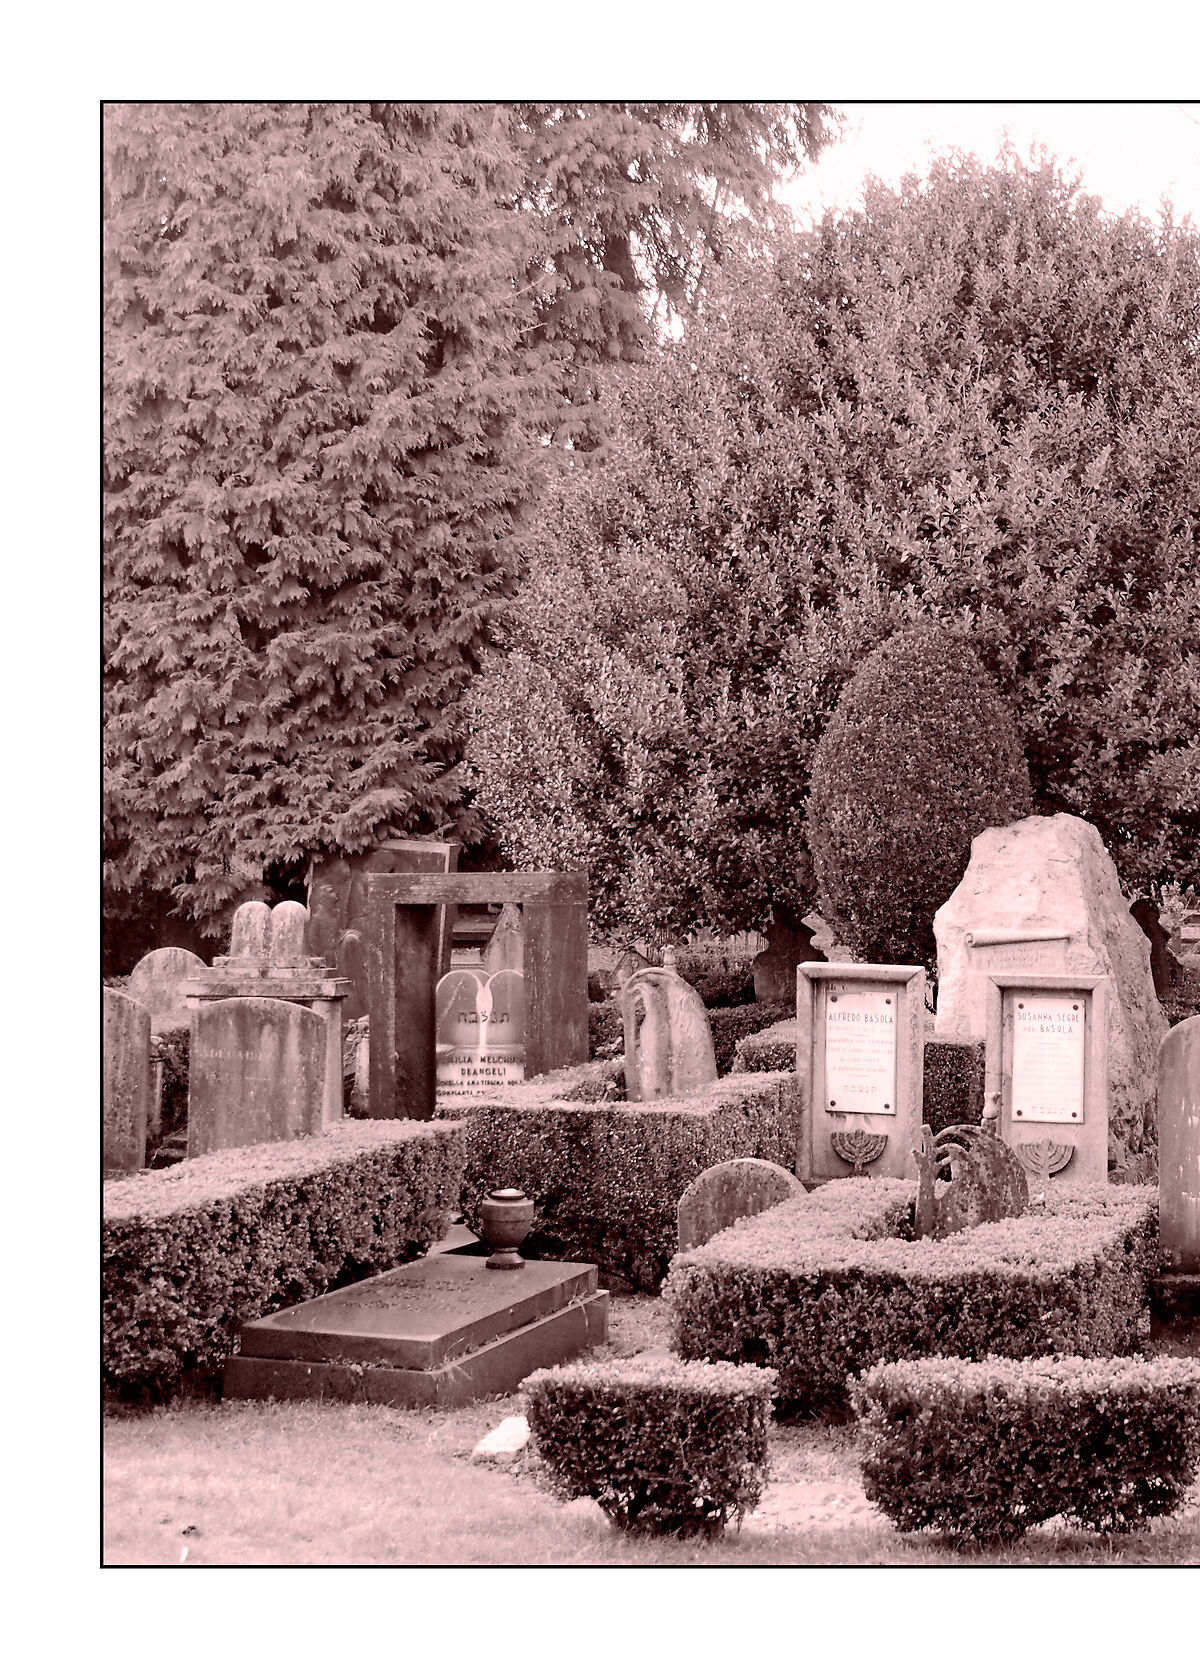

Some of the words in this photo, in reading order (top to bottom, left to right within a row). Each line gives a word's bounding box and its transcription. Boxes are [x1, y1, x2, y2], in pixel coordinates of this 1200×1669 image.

[457, 1011, 510, 1024] תנצבה
[828, 1012, 861, 1022] ALFREDO
[864, 1013, 894, 1024] BASOLA
[1017, 1012, 1053, 1022] SUSANNA
[1057, 1013, 1080, 1023] SEGRE
[1040, 1024, 1074, 1034] BASOLA
[461, 1068, 506, 1076] DEANGELI
